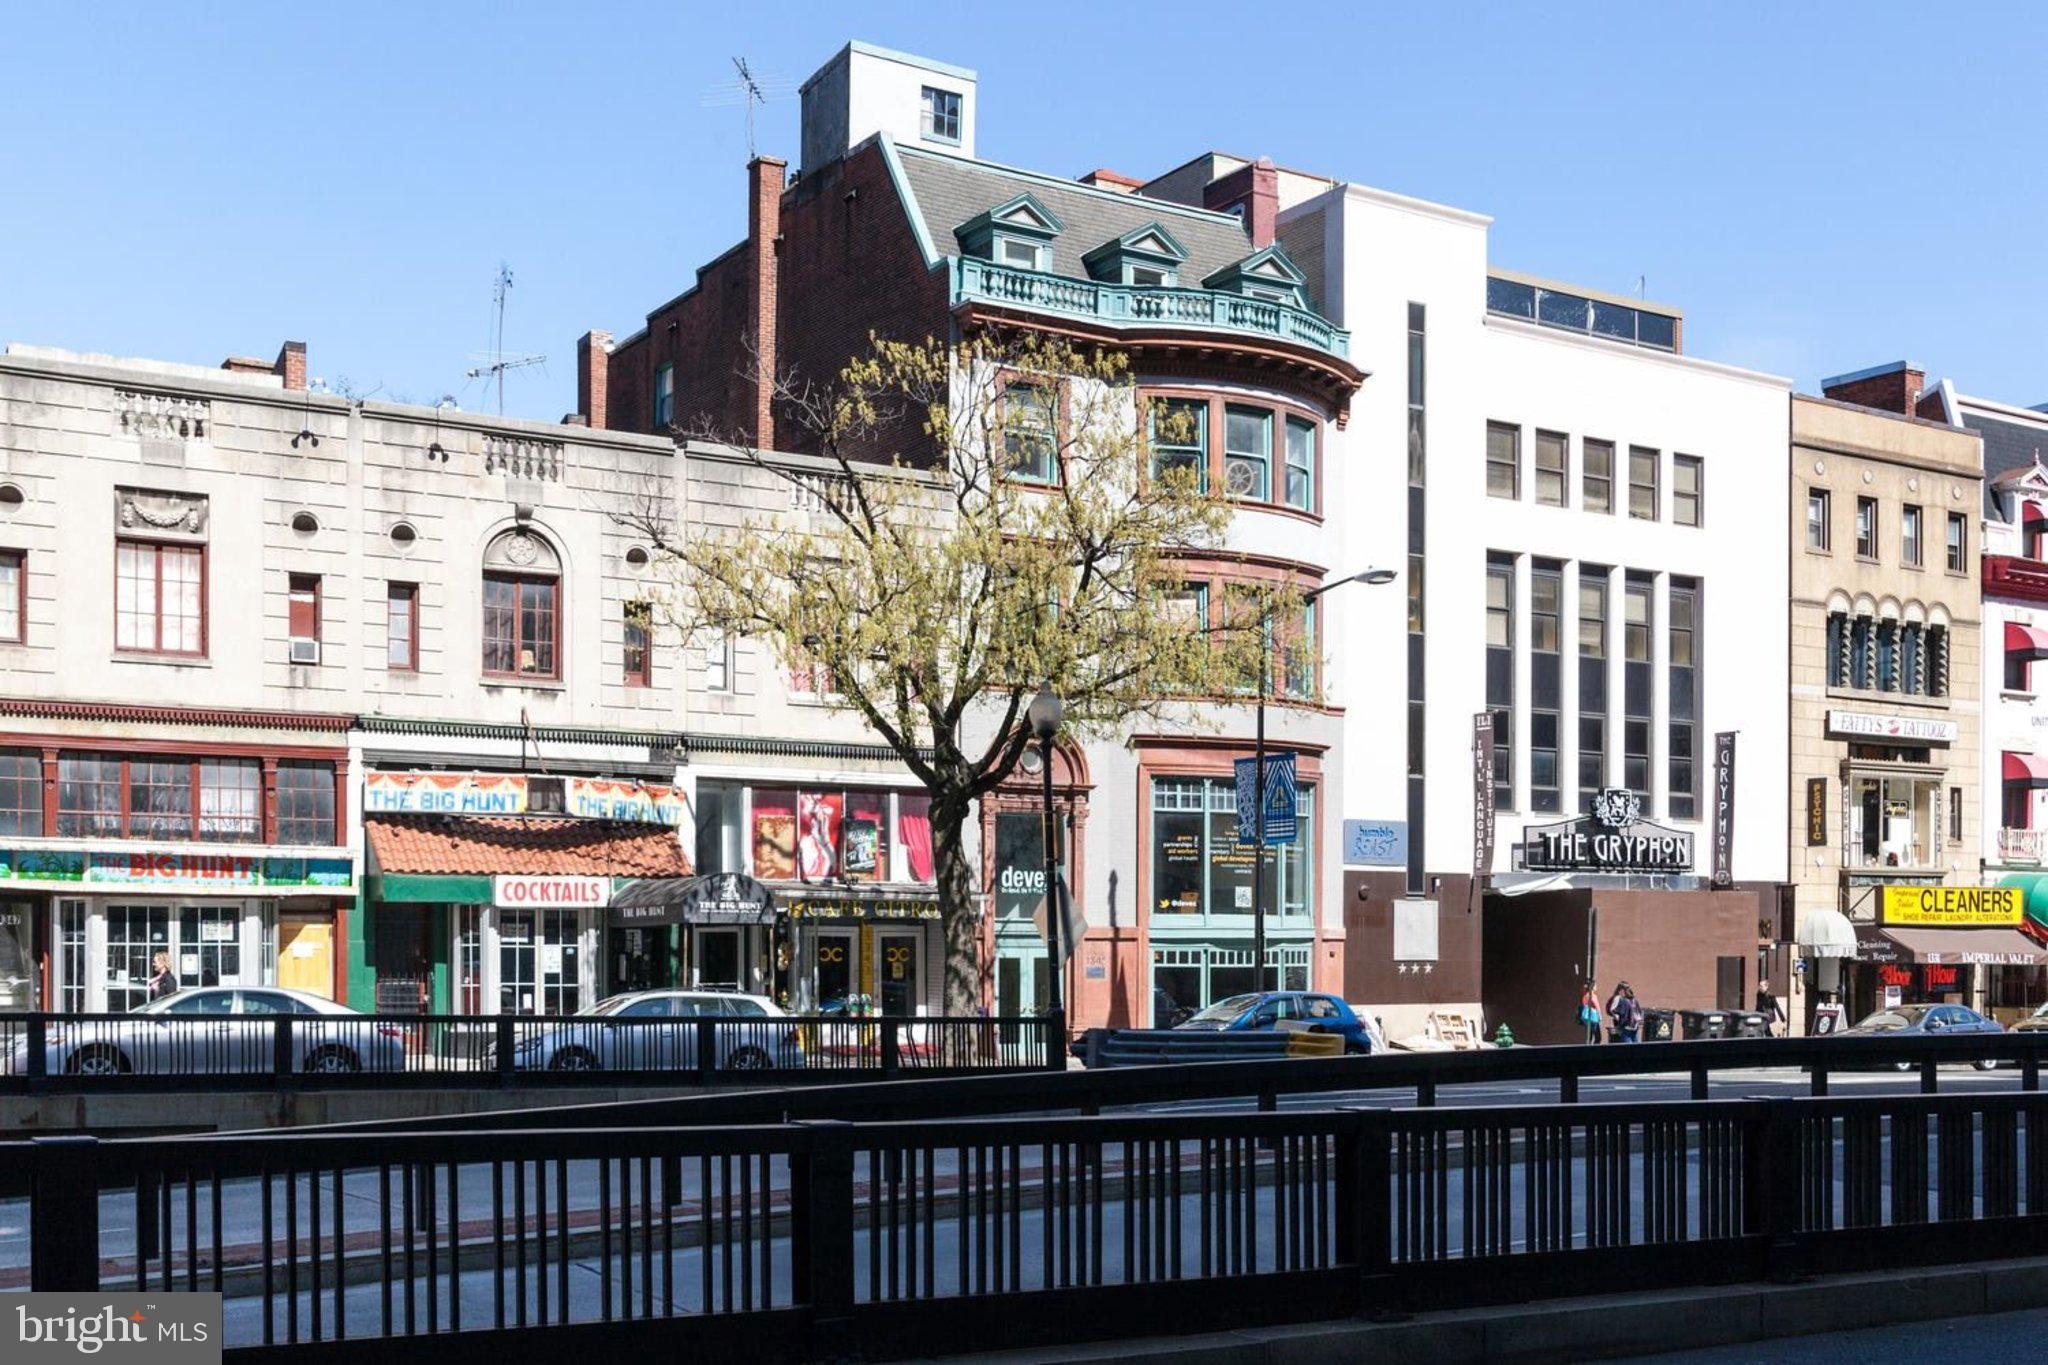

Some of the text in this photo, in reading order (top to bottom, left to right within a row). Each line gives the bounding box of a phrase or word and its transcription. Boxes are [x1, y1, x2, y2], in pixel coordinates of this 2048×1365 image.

[369, 789, 521, 812] THE BIG HUNT
[577, 795, 682, 825] THE BIG HUNT
[1718, 736, 1731, 869] THE GRYPHON
[1813, 782, 1821, 840] PSYCHIC
[1475, 792, 1484, 868] LANGUAGE
[1545, 832, 1688, 866] THE GRYPHON
[98, 852, 254, 879] THE BIG HUNT
[503, 881, 601, 902] COCKTAILS
[1920, 889, 2014, 913] CLEANERS
[622, 907, 635, 918] THE
[699, 901, 762, 911] THE BIG HUNT
[874, 901, 938, 919] CITRO
[1921, 914, 1943, 922] REPAIR
[1857, 940, 1891, 950] Cleaning
[1873, 951, 1898, 962] Repair
[1961, 951, 2007, 964] IMPERIAL
